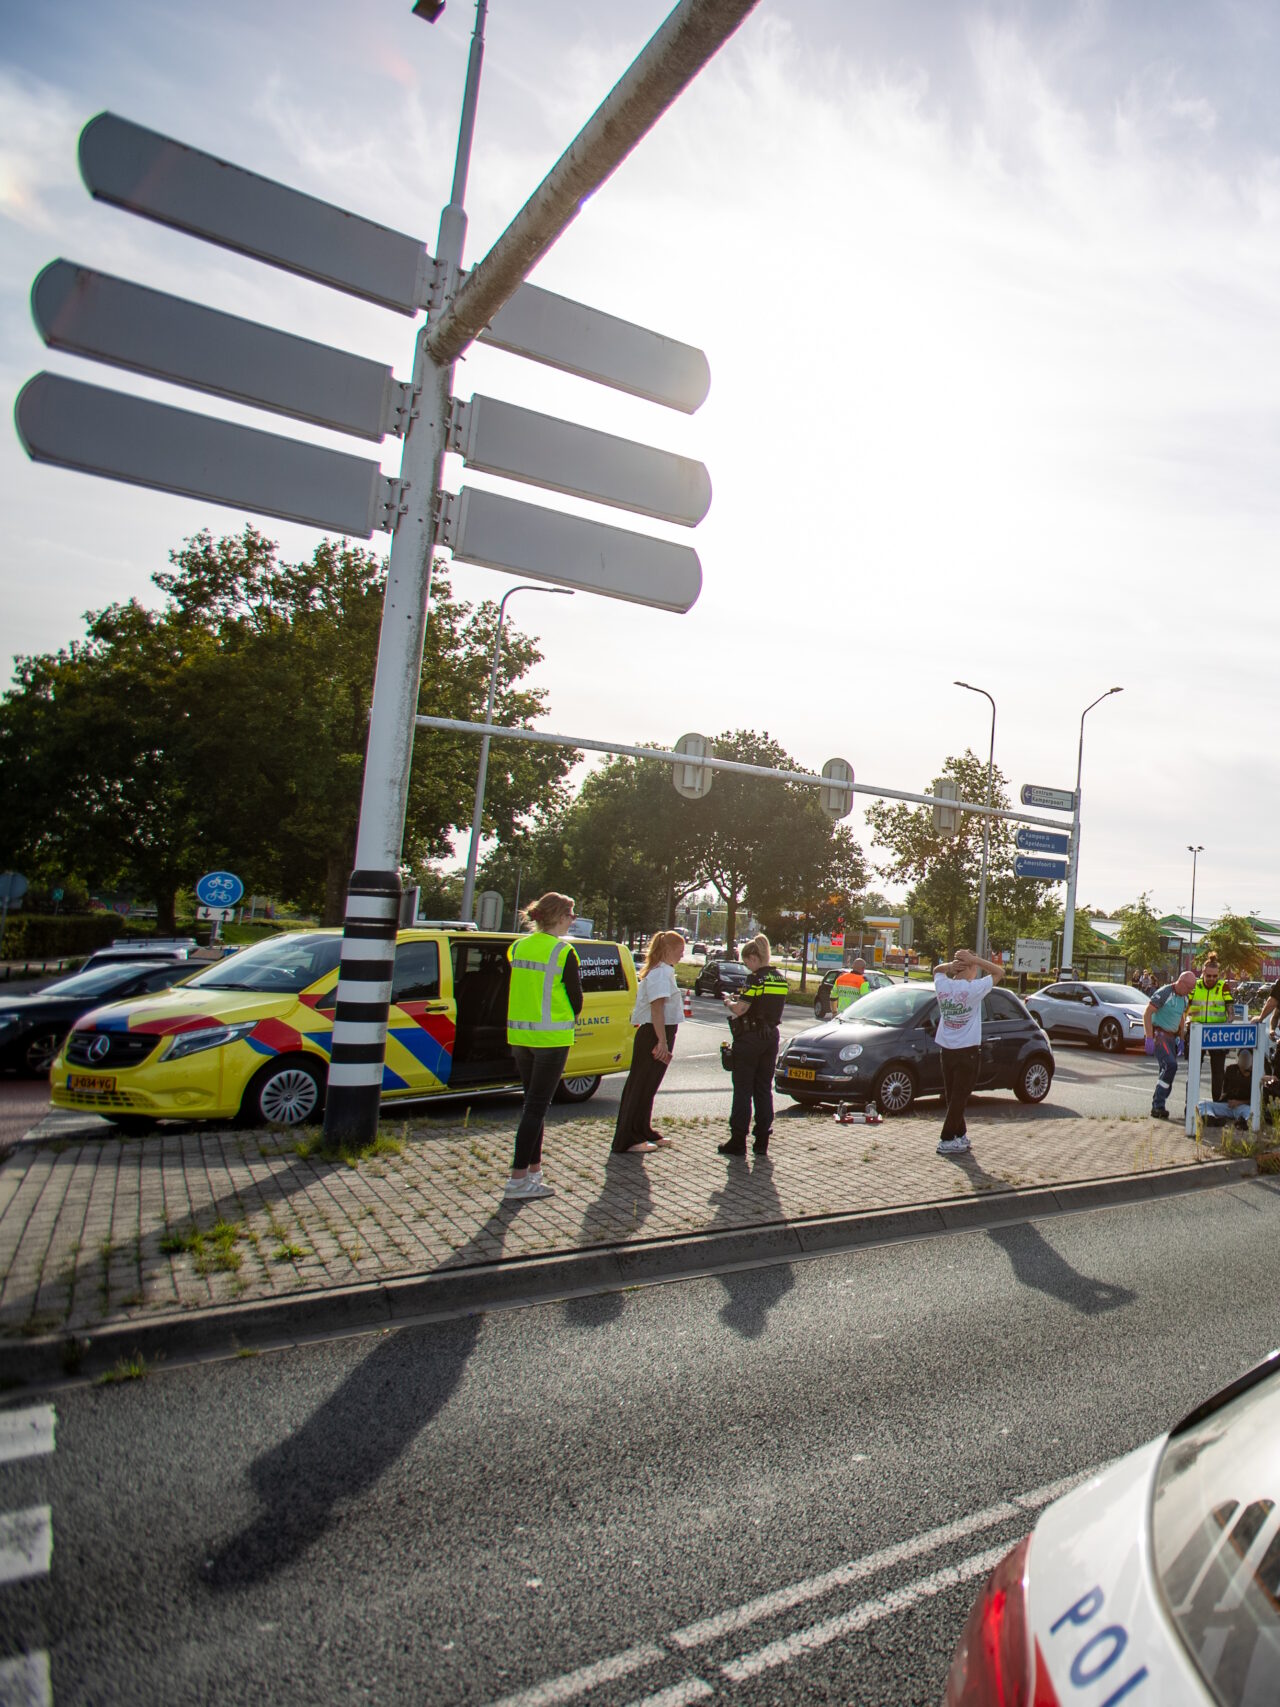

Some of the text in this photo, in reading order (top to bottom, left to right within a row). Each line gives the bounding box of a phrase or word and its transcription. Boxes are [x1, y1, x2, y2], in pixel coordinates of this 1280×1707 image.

[1032, 788, 1053, 797] Centrum
[1025, 832, 1046, 841] Kampen
[1025, 841, 1051, 849] Apeldoorn
[1023, 859, 1052, 867] Amersfoort
[580, 957, 619, 966] mbulance
[575, 1016, 610, 1026] ULANCE
[1203, 1029, 1254, 1045] Katerdijk
